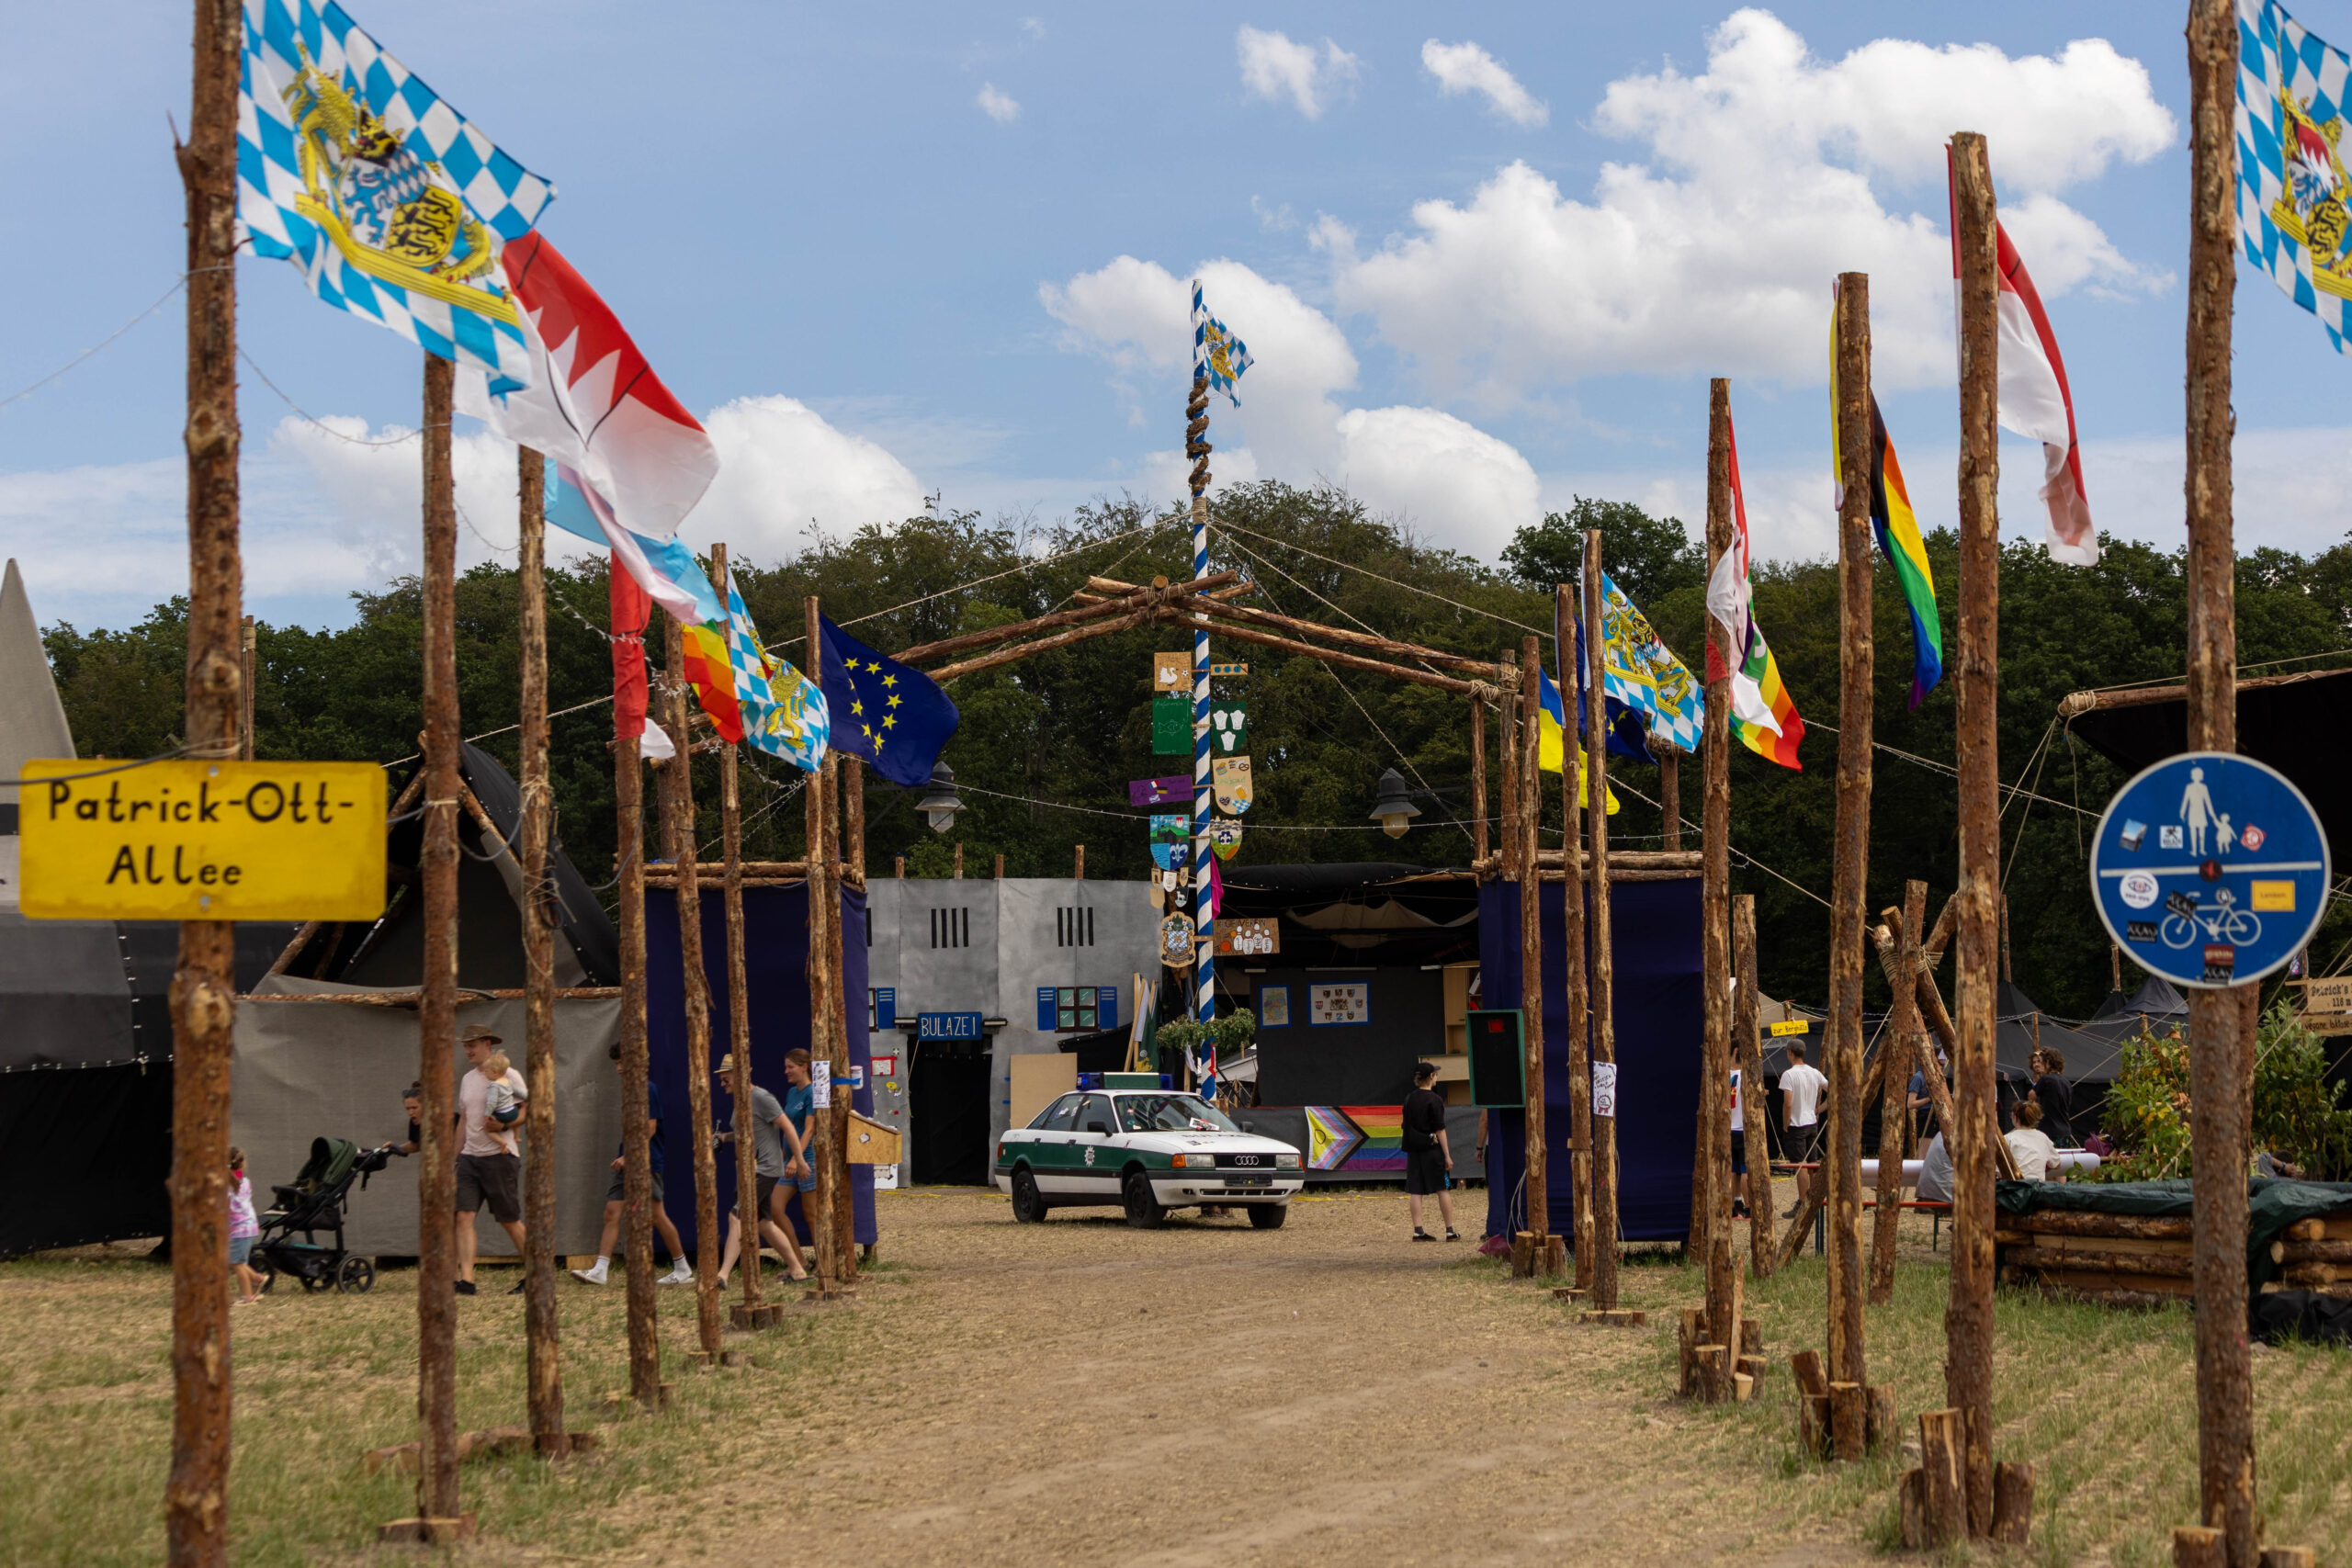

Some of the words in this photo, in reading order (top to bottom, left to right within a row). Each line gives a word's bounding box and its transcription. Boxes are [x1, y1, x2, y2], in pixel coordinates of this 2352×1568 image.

[49, 781, 354, 824] Patrick-Ott-
[106, 844, 243, 886] Allee
[921, 1016, 976, 1037] BULAZEI
